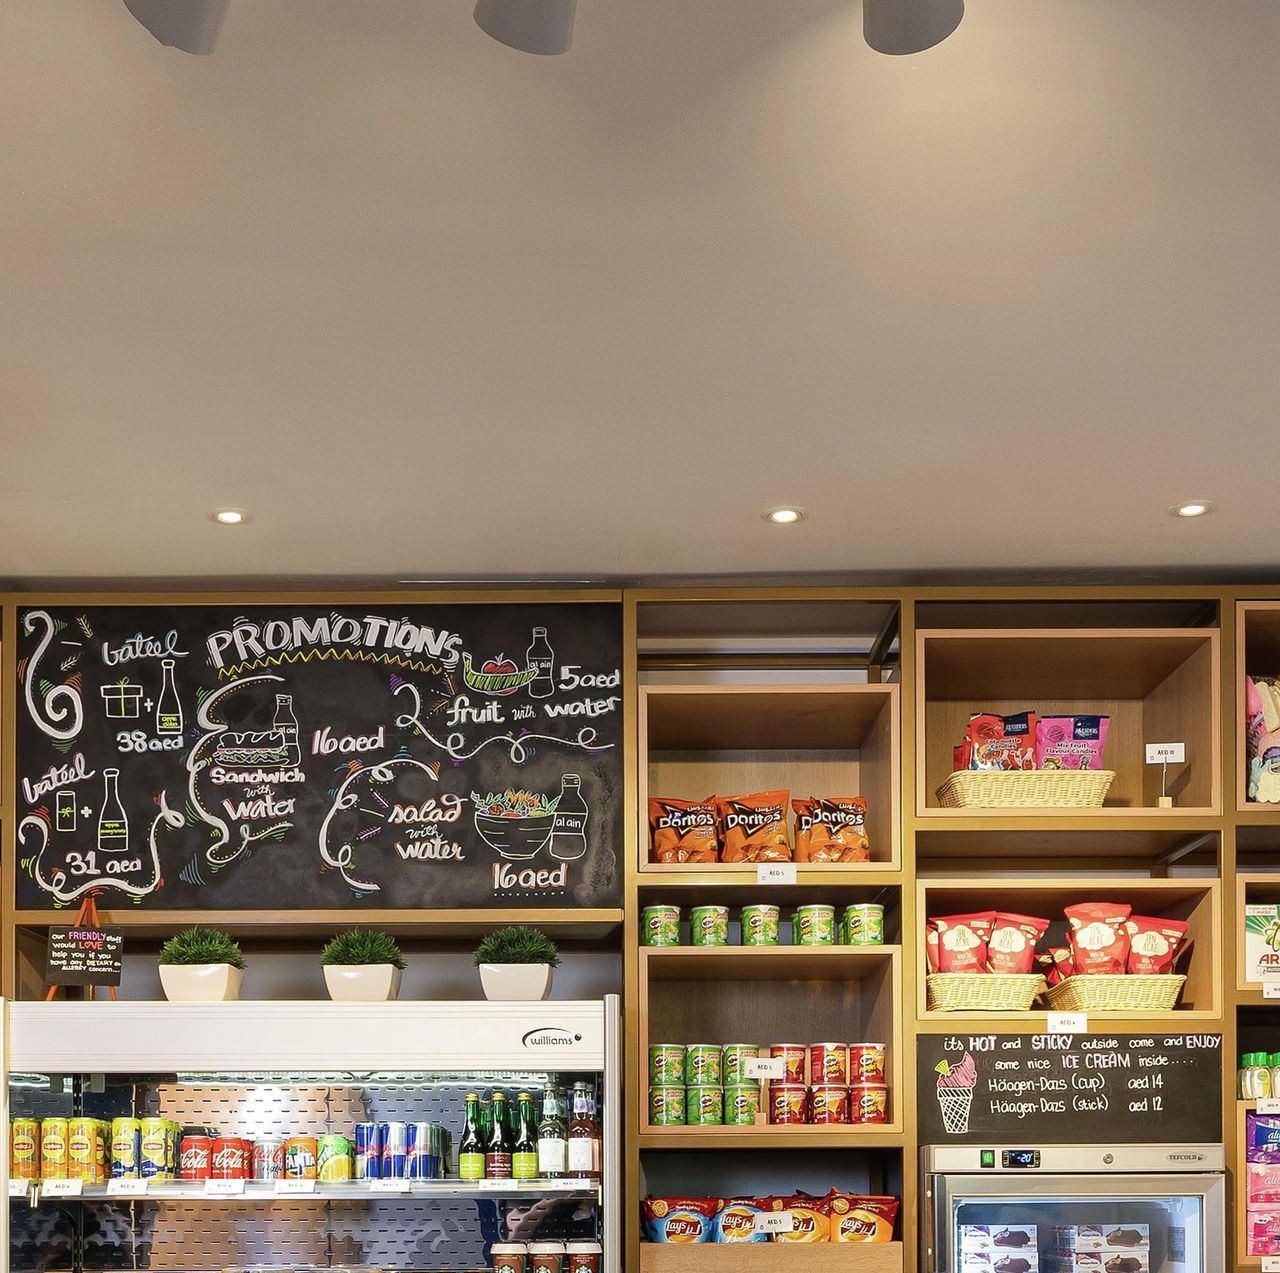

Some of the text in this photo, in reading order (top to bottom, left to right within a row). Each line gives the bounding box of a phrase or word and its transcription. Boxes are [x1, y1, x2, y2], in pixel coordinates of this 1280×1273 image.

[102, 629, 189, 667] bateel
[207, 614, 462, 669] PROMOTIONS
[447, 696, 621, 726] fruit with water
[210, 768, 305, 783] Sandwich
[244, 785, 274, 799] with
[387, 794, 468, 825] salad
[812, 809, 865, 826] Doritos
[659, 812, 714, 829] Doritos
[727, 810, 781, 828] Doritos
[405, 825, 443, 839] with
[395, 838, 465, 861] water
[66, 851, 142, 875] 31 aed
[68, 931, 107, 941] FRIENDLY
[79, 941, 103, 950] LOVE
[51, 950, 68, 959] help
[530, 1036, 573, 1046] williams
[969, 1036, 996, 1051] HOT
[1002, 1037, 1021, 1049] and
[1032, 1035, 1073, 1050] STICKY
[1081, 1038, 1119, 1050] outside
[1129, 1039, 1154, 1048] come
[1163, 1036, 1183, 1047] and
[1186, 1036, 1220, 1049] ENJOY
[995, 1060, 1020, 1070] some
[1027, 1058, 1051, 1069] nice
[1062, 1055, 1079, 1069] ICE
[1085, 1053, 1131, 1069] CREAM
[1072, 1073, 1105, 1096] (cup)
[1128, 1075, 1149, 1089] aed
[1152, 1075, 1164, 1089] 14
[1072, 1096, 1109, 1112] (stick)
[1128, 1099, 1148, 1112] aed
[1152, 1099, 1164, 1112] 12
